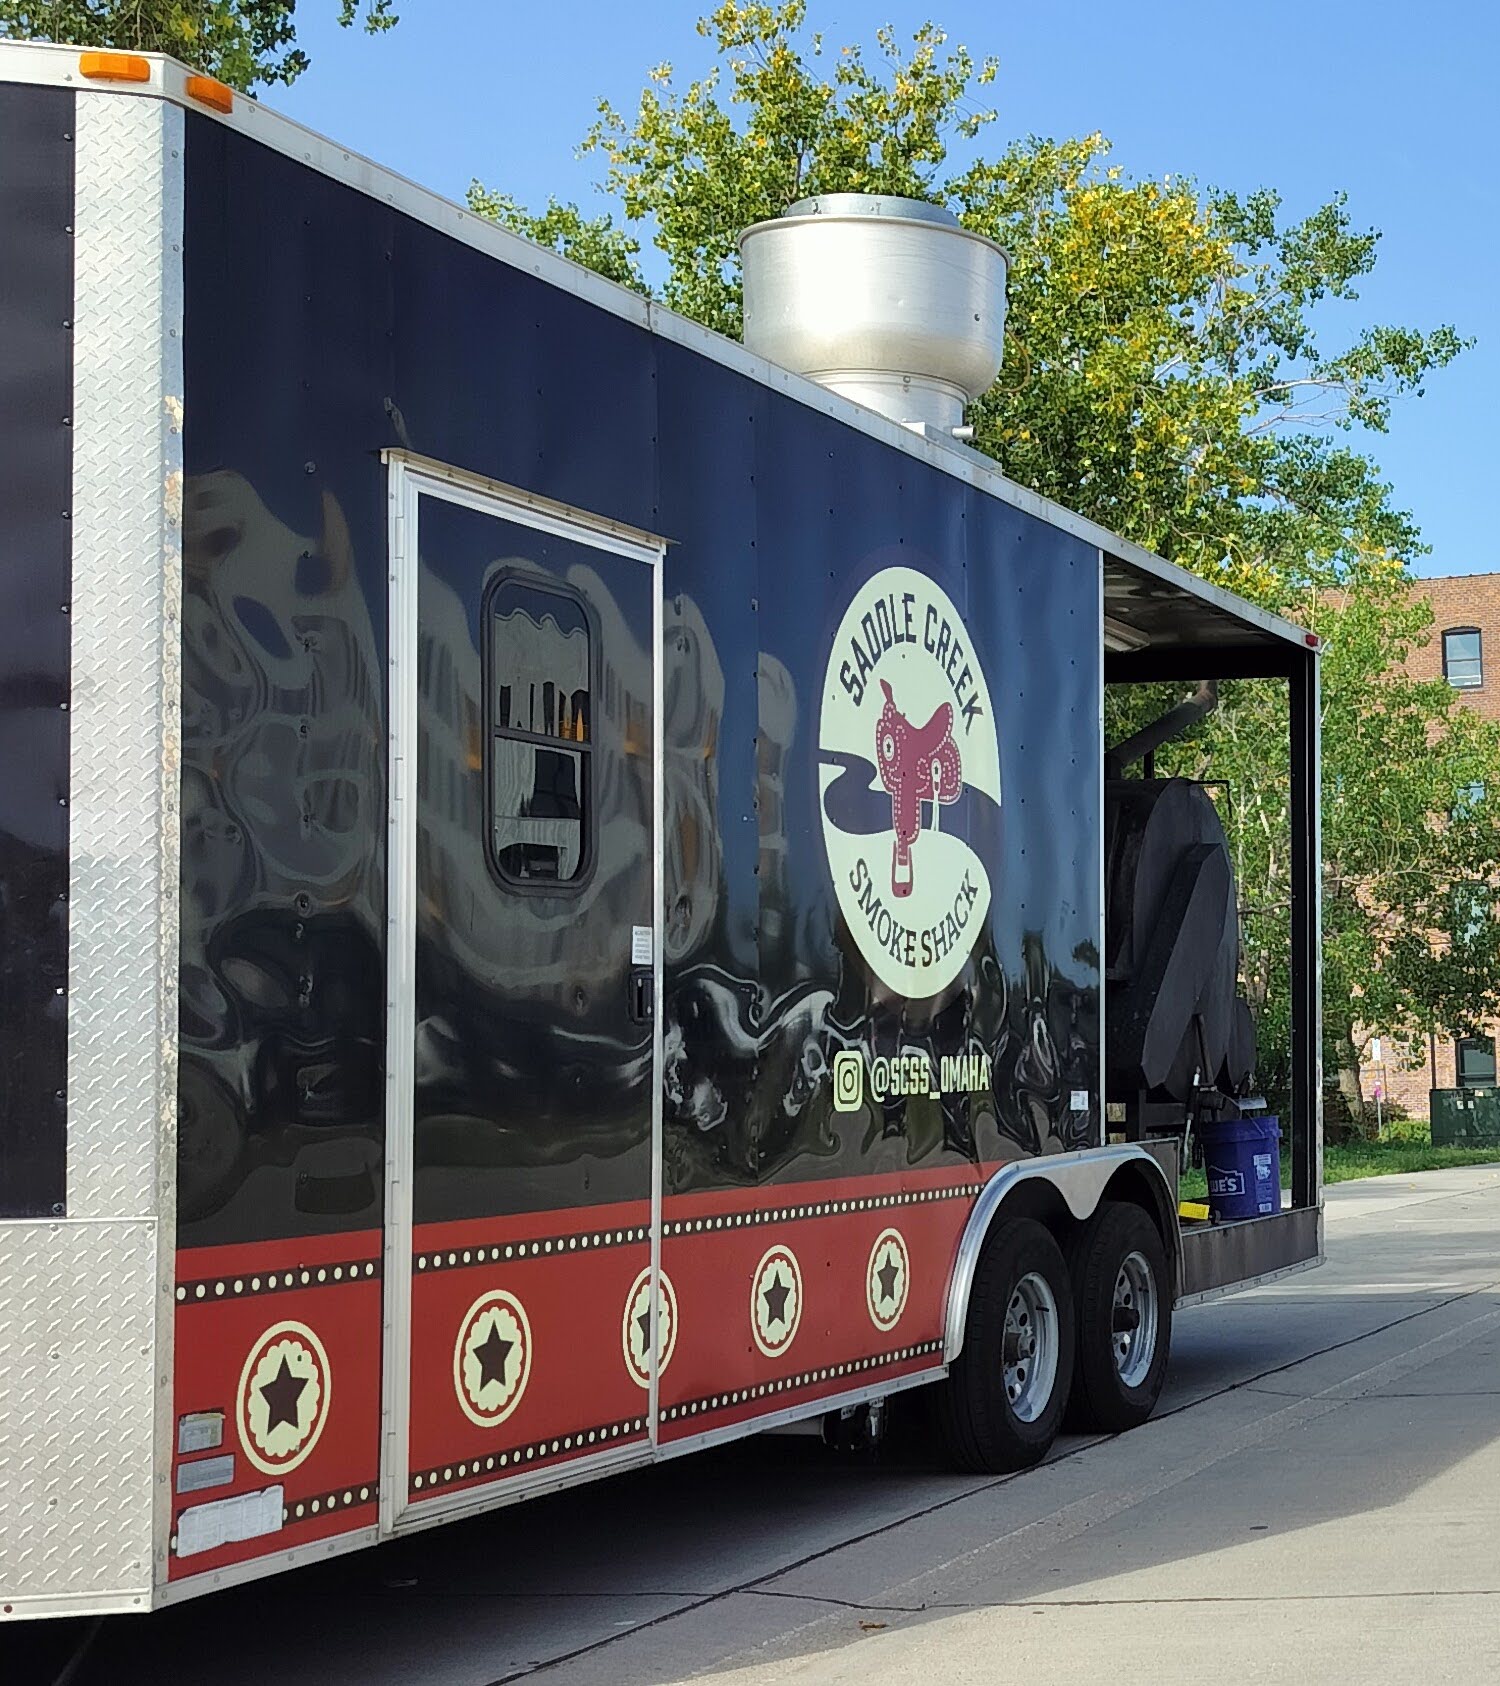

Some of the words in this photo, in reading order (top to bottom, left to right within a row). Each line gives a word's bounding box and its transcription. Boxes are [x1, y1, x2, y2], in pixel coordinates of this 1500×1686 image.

[839, 592, 917, 707] SADDLE
[924, 603, 984, 736] CREEK
[849, 858, 917, 968] SMOKE
[921, 868, 979, 968] SHACK
[870, 1055, 989, 1102] @SCSS_OMAHA
[1209, 1176, 1237, 1193] WE'S
